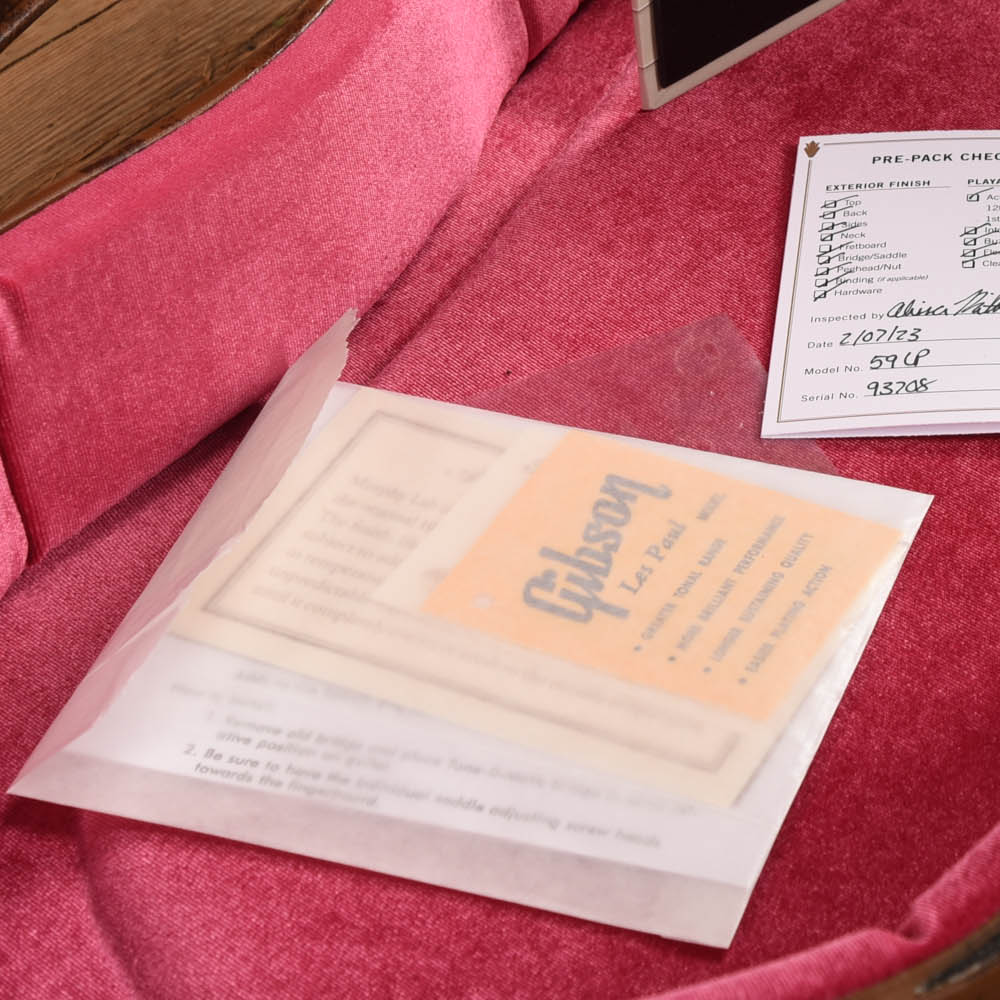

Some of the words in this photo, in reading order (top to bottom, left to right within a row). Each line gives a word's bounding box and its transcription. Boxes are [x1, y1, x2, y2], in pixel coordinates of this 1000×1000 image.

[872, 153, 953, 165] PRE-PACK
[826, 182, 884, 191] EXTERIOR
[845, 199, 862, 207] Top
[840, 241, 887, 250] Fretboard
[838, 252, 908, 262] Bridge/Saddle
[837, 263, 902, 273] Peghead/Nut
[834, 288, 883, 296] Hardware
[810, 312, 866, 323] Inspected
[807, 341, 834, 349] Date
[839, 325, 922, 346] 2/07/23
[804, 365, 839, 375] Model
[844, 364, 863, 373] No.
[801, 393, 834, 402] Serial
[839, 392, 858, 400] No.
[522, 473, 674, 623] Gibson
[619, 564, 654, 595] Les
[645, 519, 687, 563] Paul
